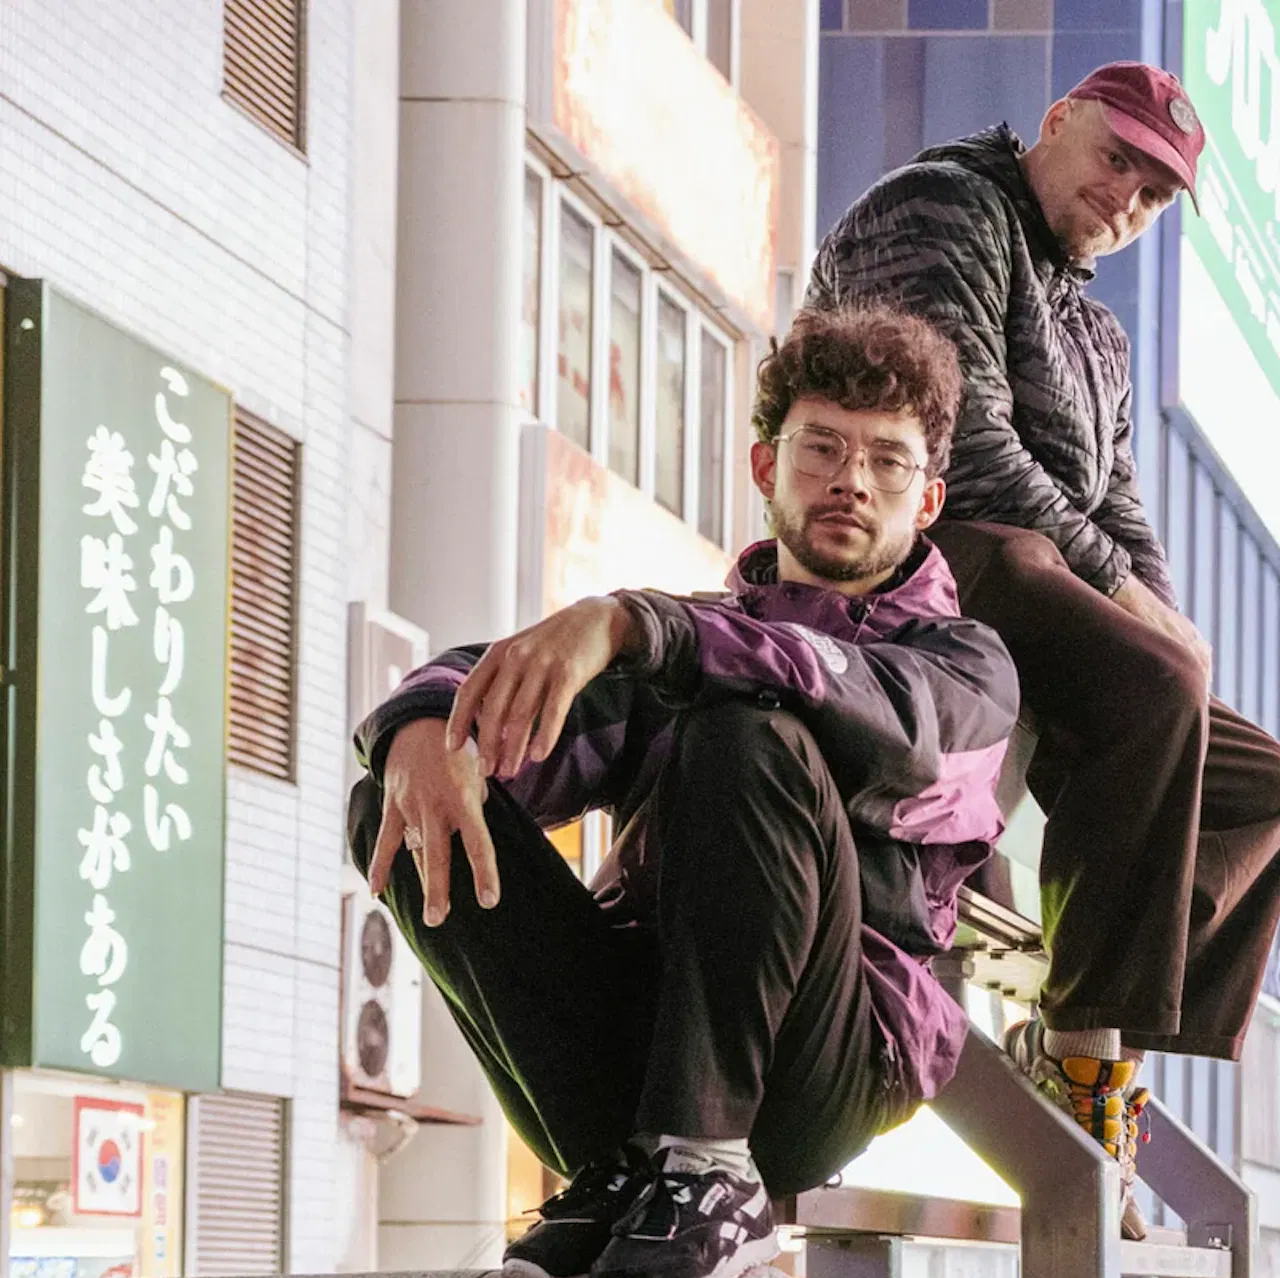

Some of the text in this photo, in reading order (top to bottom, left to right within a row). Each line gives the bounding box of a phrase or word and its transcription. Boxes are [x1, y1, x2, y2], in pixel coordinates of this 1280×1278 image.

[78, 424, 140, 1068] 美味しさがある
[141, 364, 200, 854] こだわりたい
